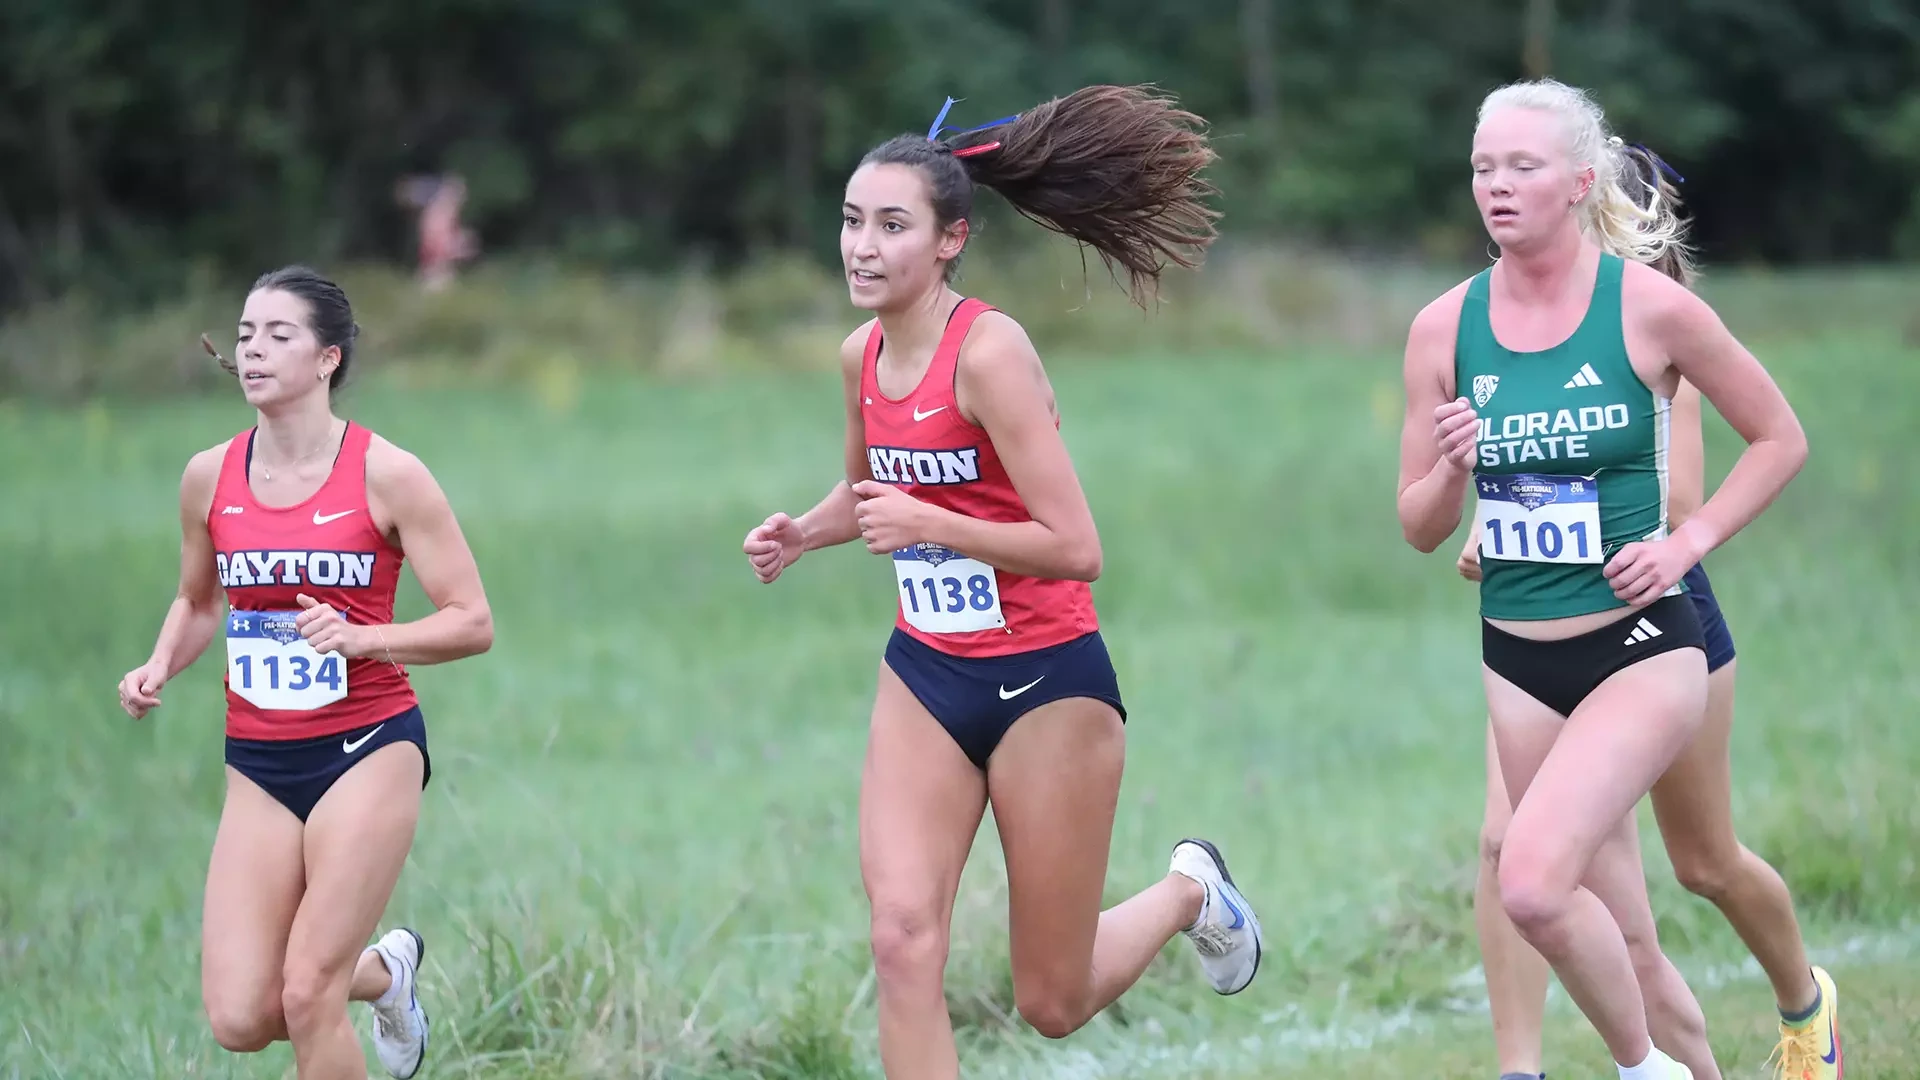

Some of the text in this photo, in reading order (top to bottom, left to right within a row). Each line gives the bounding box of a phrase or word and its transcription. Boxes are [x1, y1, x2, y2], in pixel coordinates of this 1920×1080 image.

[866, 447, 980, 485] AYTON
[1479, 434, 1590, 467] STATE
[1485, 518, 1589, 559] 1101
[902, 574, 994, 614] 1138
[235, 654, 342, 691] 1134
